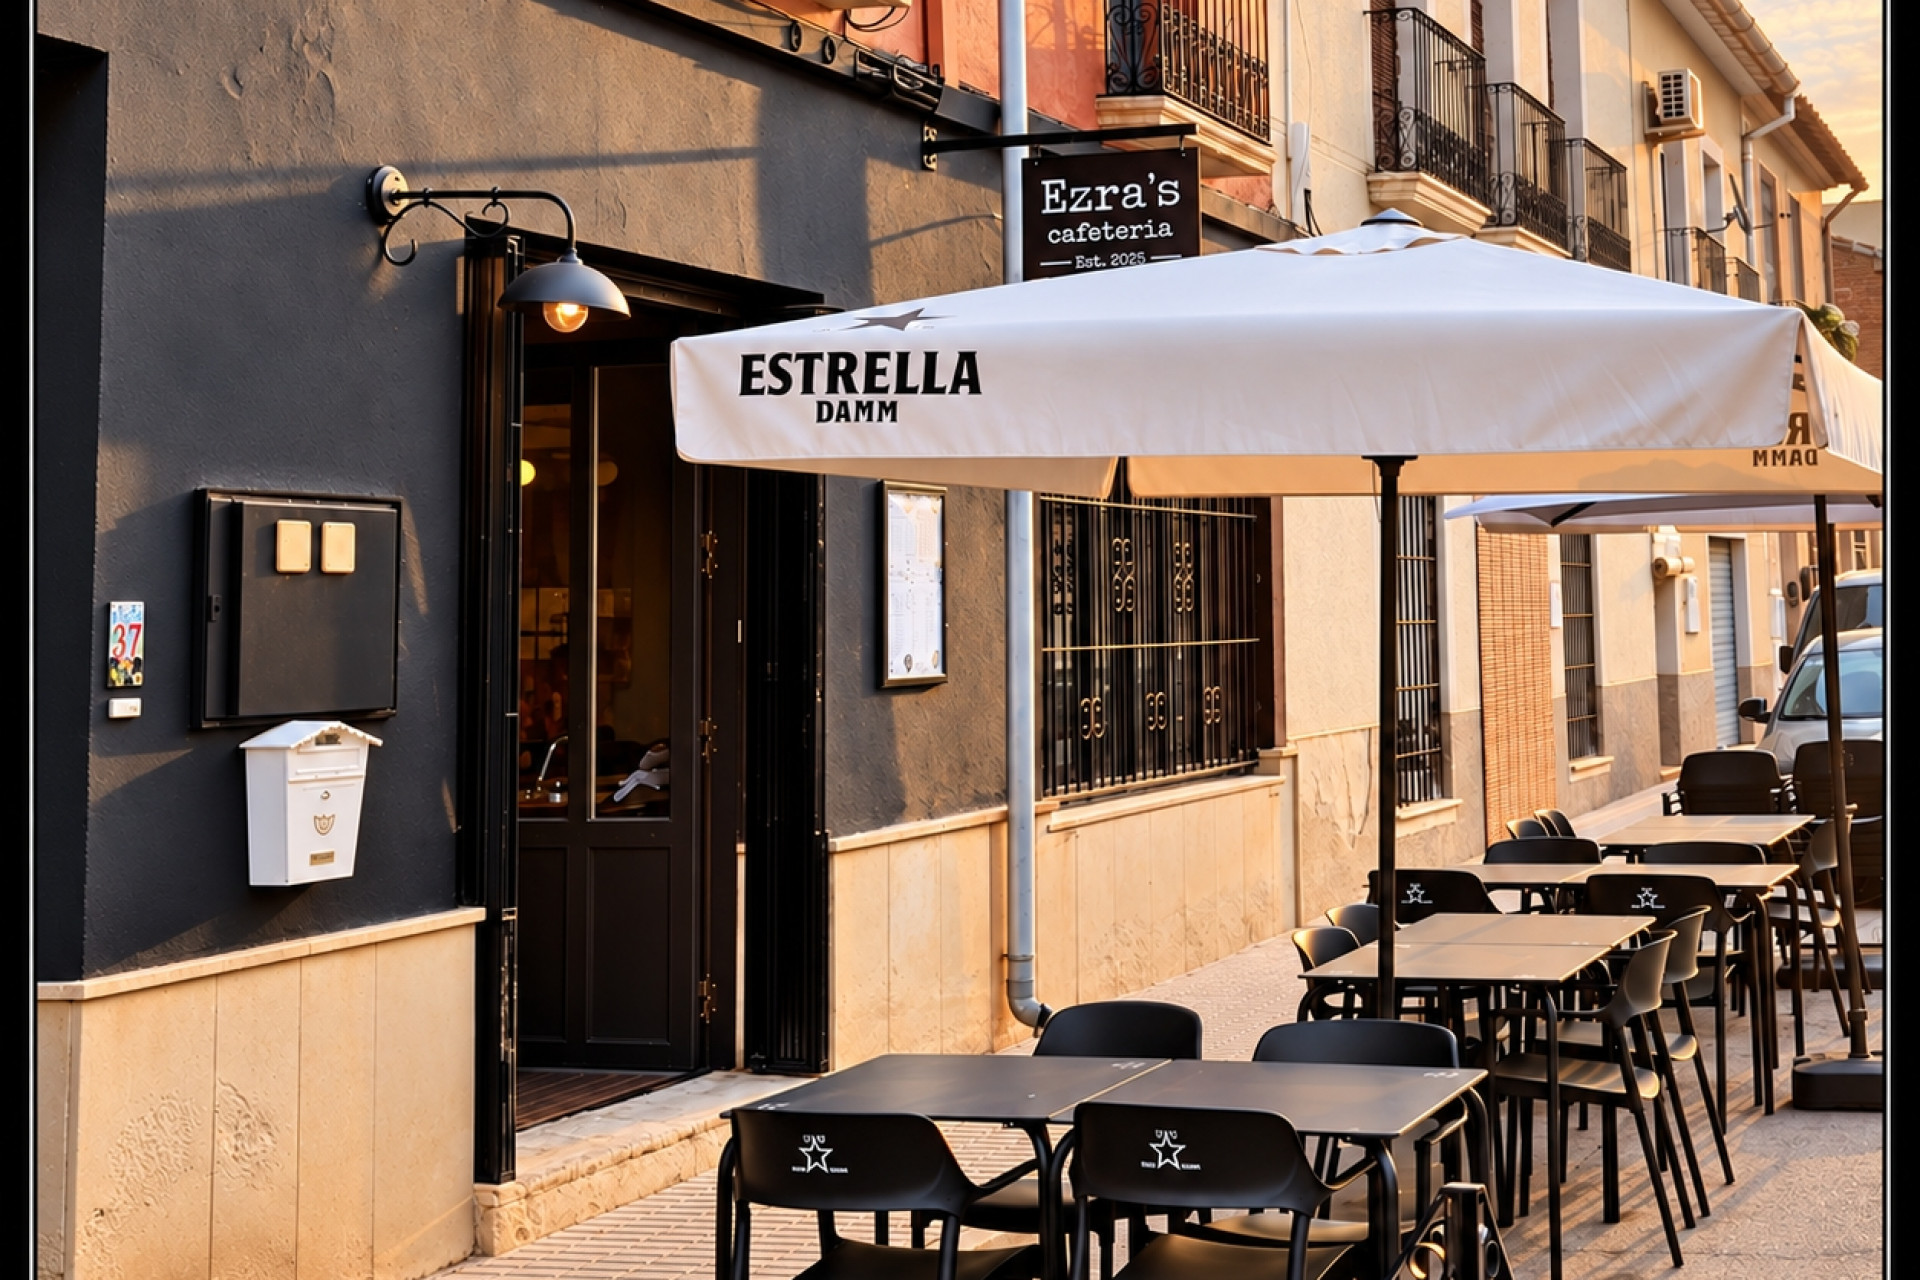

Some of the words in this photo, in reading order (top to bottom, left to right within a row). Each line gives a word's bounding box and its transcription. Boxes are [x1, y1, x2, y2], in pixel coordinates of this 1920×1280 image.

[1040, 172, 1181, 214] Ezra's
[1048, 219, 1174, 245] cafeteria
[1075, 255, 1106, 269] Est.
[1110, 252, 1146, 267] 2025
[739, 351, 982, 396] ESTRELLA
[816, 400, 898, 423] DAMM
[112, 623, 142, 659] 37
